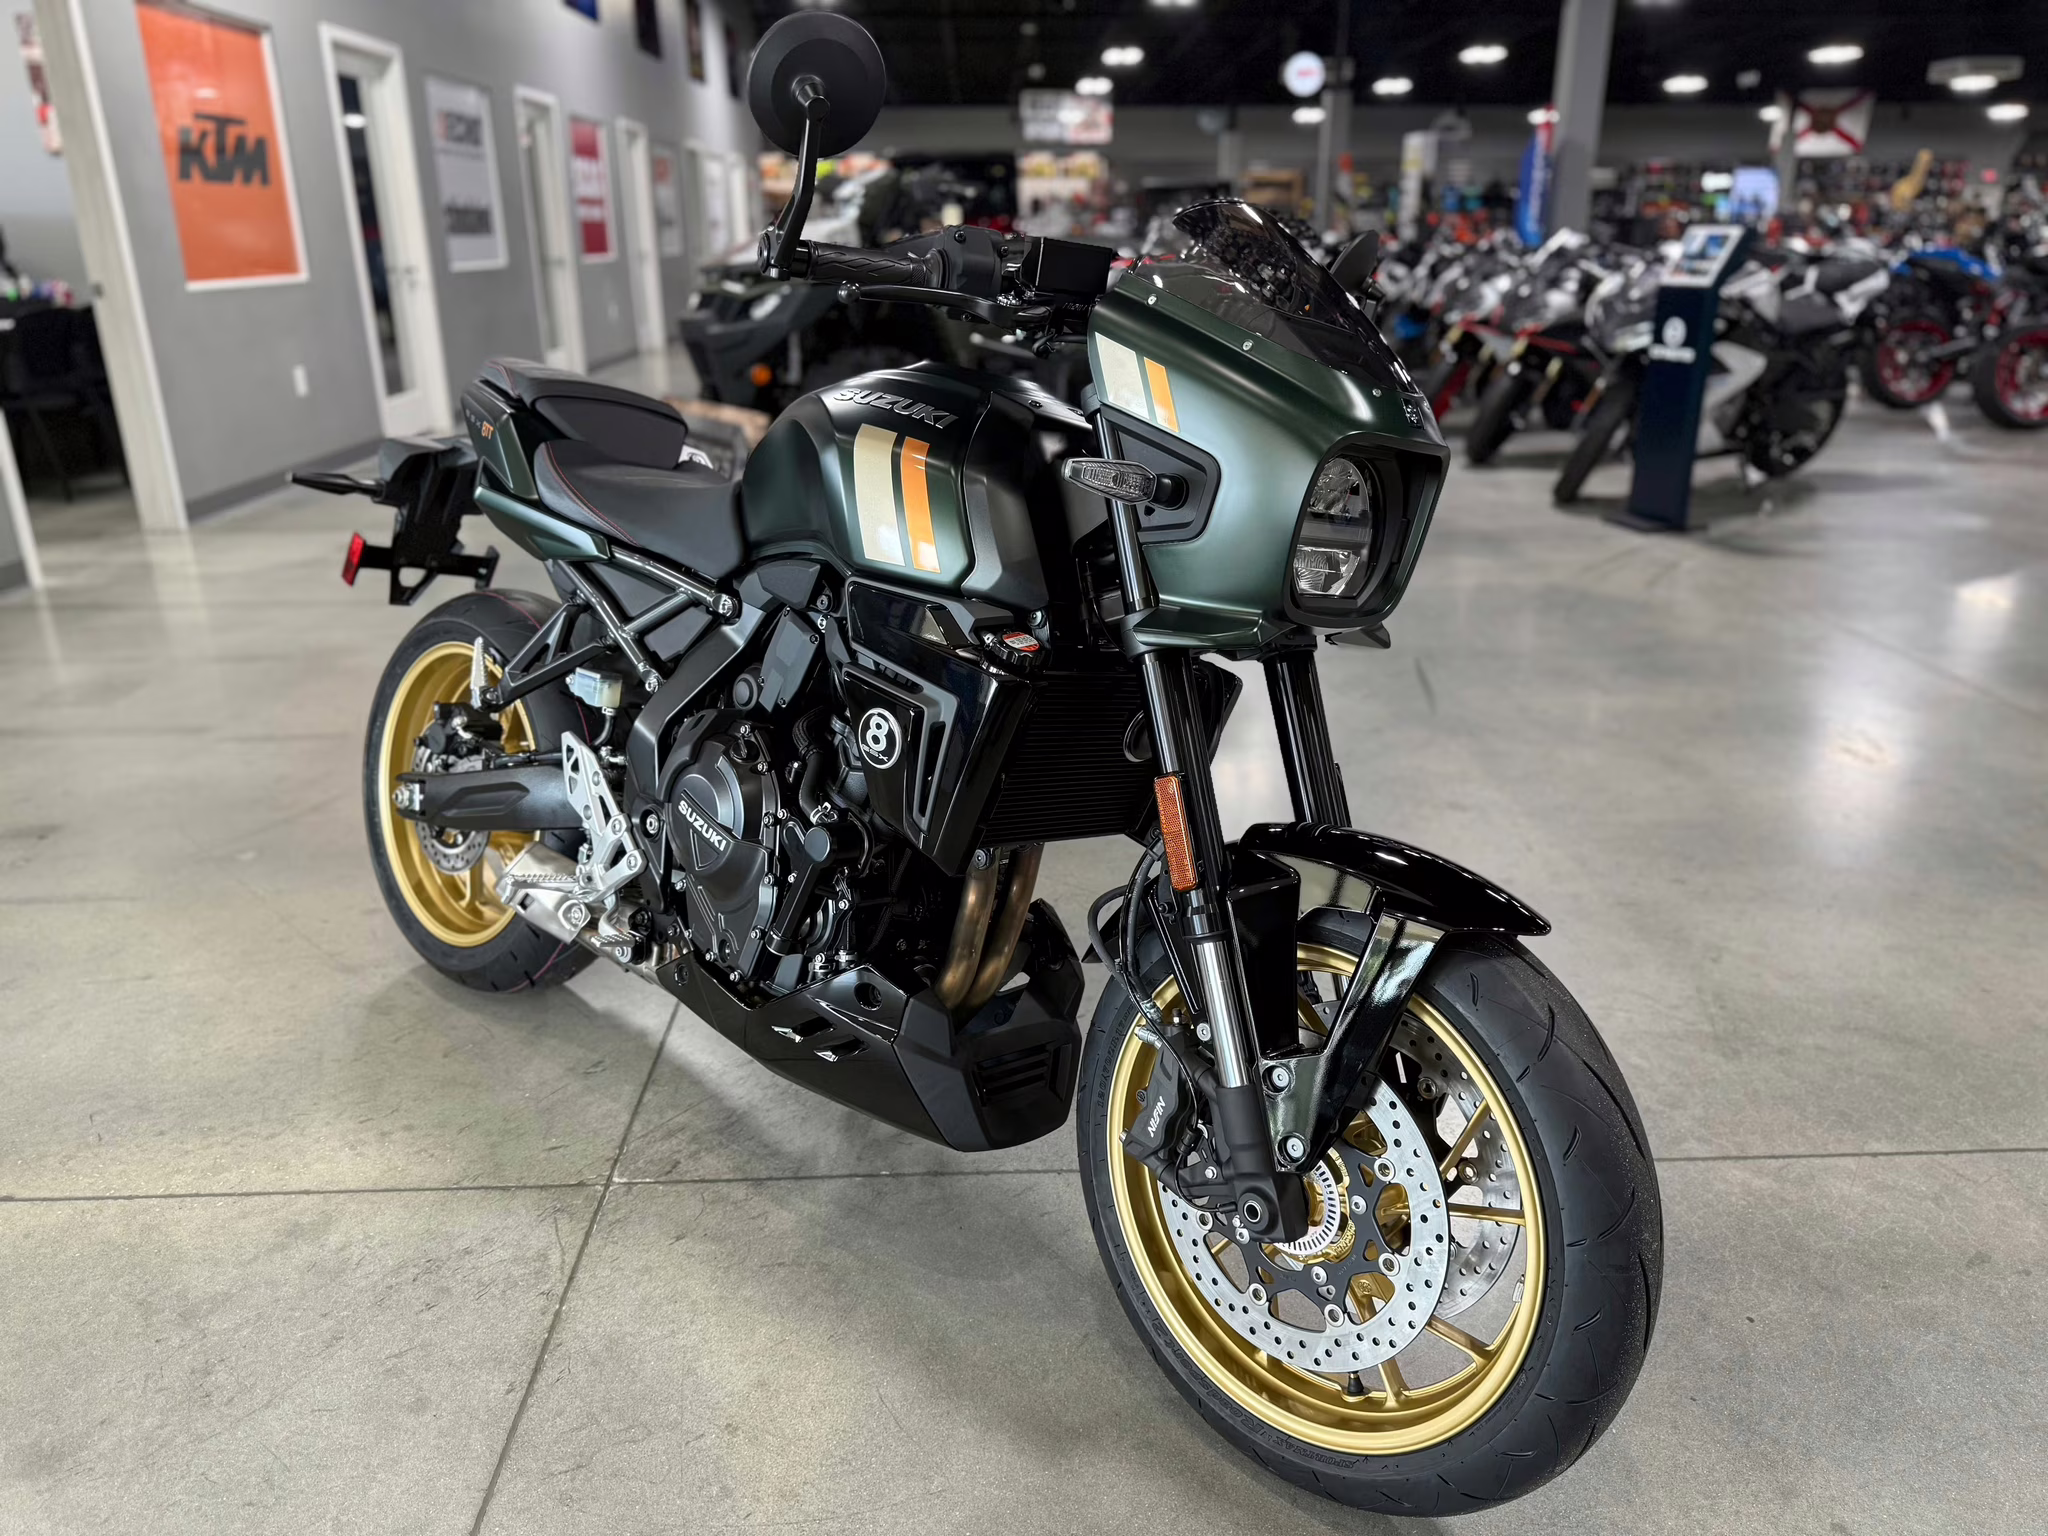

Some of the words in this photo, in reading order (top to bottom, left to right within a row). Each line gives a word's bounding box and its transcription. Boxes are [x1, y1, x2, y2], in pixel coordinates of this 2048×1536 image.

[178, 112, 269, 187] KTM
[833, 387, 959, 429] SUZUKI
[866, 714, 889, 752] 8
[678, 800, 727, 851] SUZUKI
